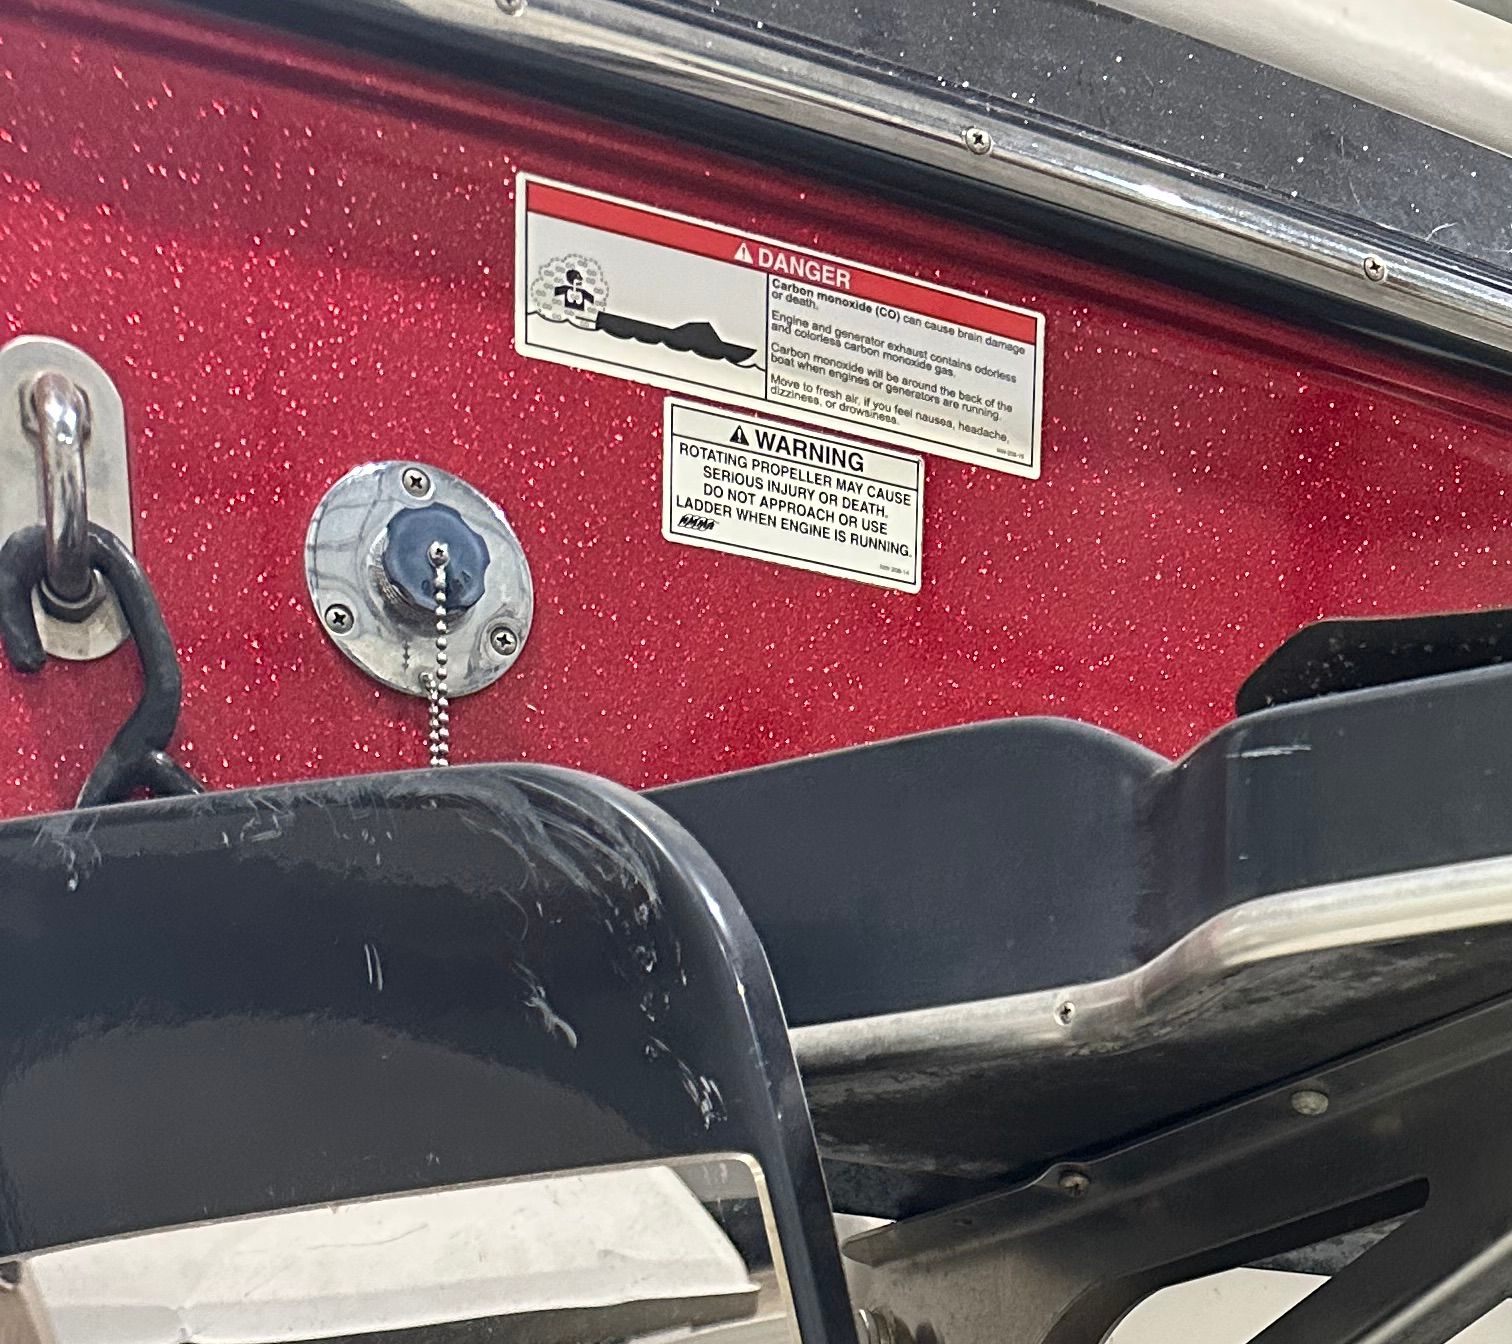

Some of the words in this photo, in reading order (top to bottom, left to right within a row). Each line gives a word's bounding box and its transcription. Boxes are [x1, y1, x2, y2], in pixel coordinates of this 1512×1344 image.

[758, 247, 850, 289] DANGER
[772, 291, 783, 300] or
[786, 292, 818, 310] death.
[772, 279, 814, 297] Carbon
[817, 292, 872, 313] monoxide
[875, 306, 901, 322] (CO)
[903, 315, 921, 327] can
[925, 321, 955, 335] cause
[958, 328, 983, 344] brain
[985, 336, 1025, 355] damage
[771, 322, 791, 334] and
[795, 328, 841, 347] colorless
[844, 341, 880, 357] carbon
[883, 351, 932, 370] monoxide
[935, 365, 956, 378] gas.
[772, 310, 809, 327] Engine
[812, 322, 831, 334] and
[835, 328, 885, 347] generator
[887, 342, 927, 359] exhaust
[930, 354, 972, 371] contains
[974, 365, 1017, 383] odorless
[771, 342, 810, 360] Carbon
[813, 354, 864, 374] monoxide
[867, 368, 883, 379] will
[886, 371, 899, 383] be
[902, 377, 937, 393] around
[940, 386, 956, 397] the
[959, 390, 982, 405] back
[985, 399, 995, 408] of
[997, 400, 1013, 412] the
[771, 353, 794, 367] boat
[797, 362, 825, 375] when
[829, 369, 870, 386] engines
[872, 380, 883, 389] or
[885, 384, 940, 404] generators
[943, 399, 959, 409] are
[825, 400, 836, 409] or
[771, 373, 800, 389] Move
[803, 381, 813, 393] to
[816, 385, 842, 400] fresh
[863, 396, 870, 406] if
[873, 401, 891, 412] you
[894, 404, 912, 418] feel
[915, 411, 955, 430] nausea,
[958, 420, 1010, 444] headache,
[680, 442, 748, 469] ROTATING
[752, 458, 832, 488] PROPELLER
[836, 477, 863, 495] MAY
[867, 485, 911, 507] CAUSE
[755, 429, 864, 472] WARNING
[703, 465, 763, 490] SERIOUS
[767, 479, 815, 501] INJURY
[819, 491, 838, 507] OR
[842, 497, 888, 518] DEATH.
[704, 483, 723, 498] DO
[727, 488, 756, 505] NOT
[760, 496, 835, 523] APPROACH
[839, 513, 857, 528] OR
[862, 518, 887, 535] USE
[676, 495, 732, 518] LADDER
[736, 507, 776, 527] WHEN
[781, 518, 830, 540] ENGINE
[835, 529, 846, 543] IS
[850, 532, 912, 558] RUNNING.
